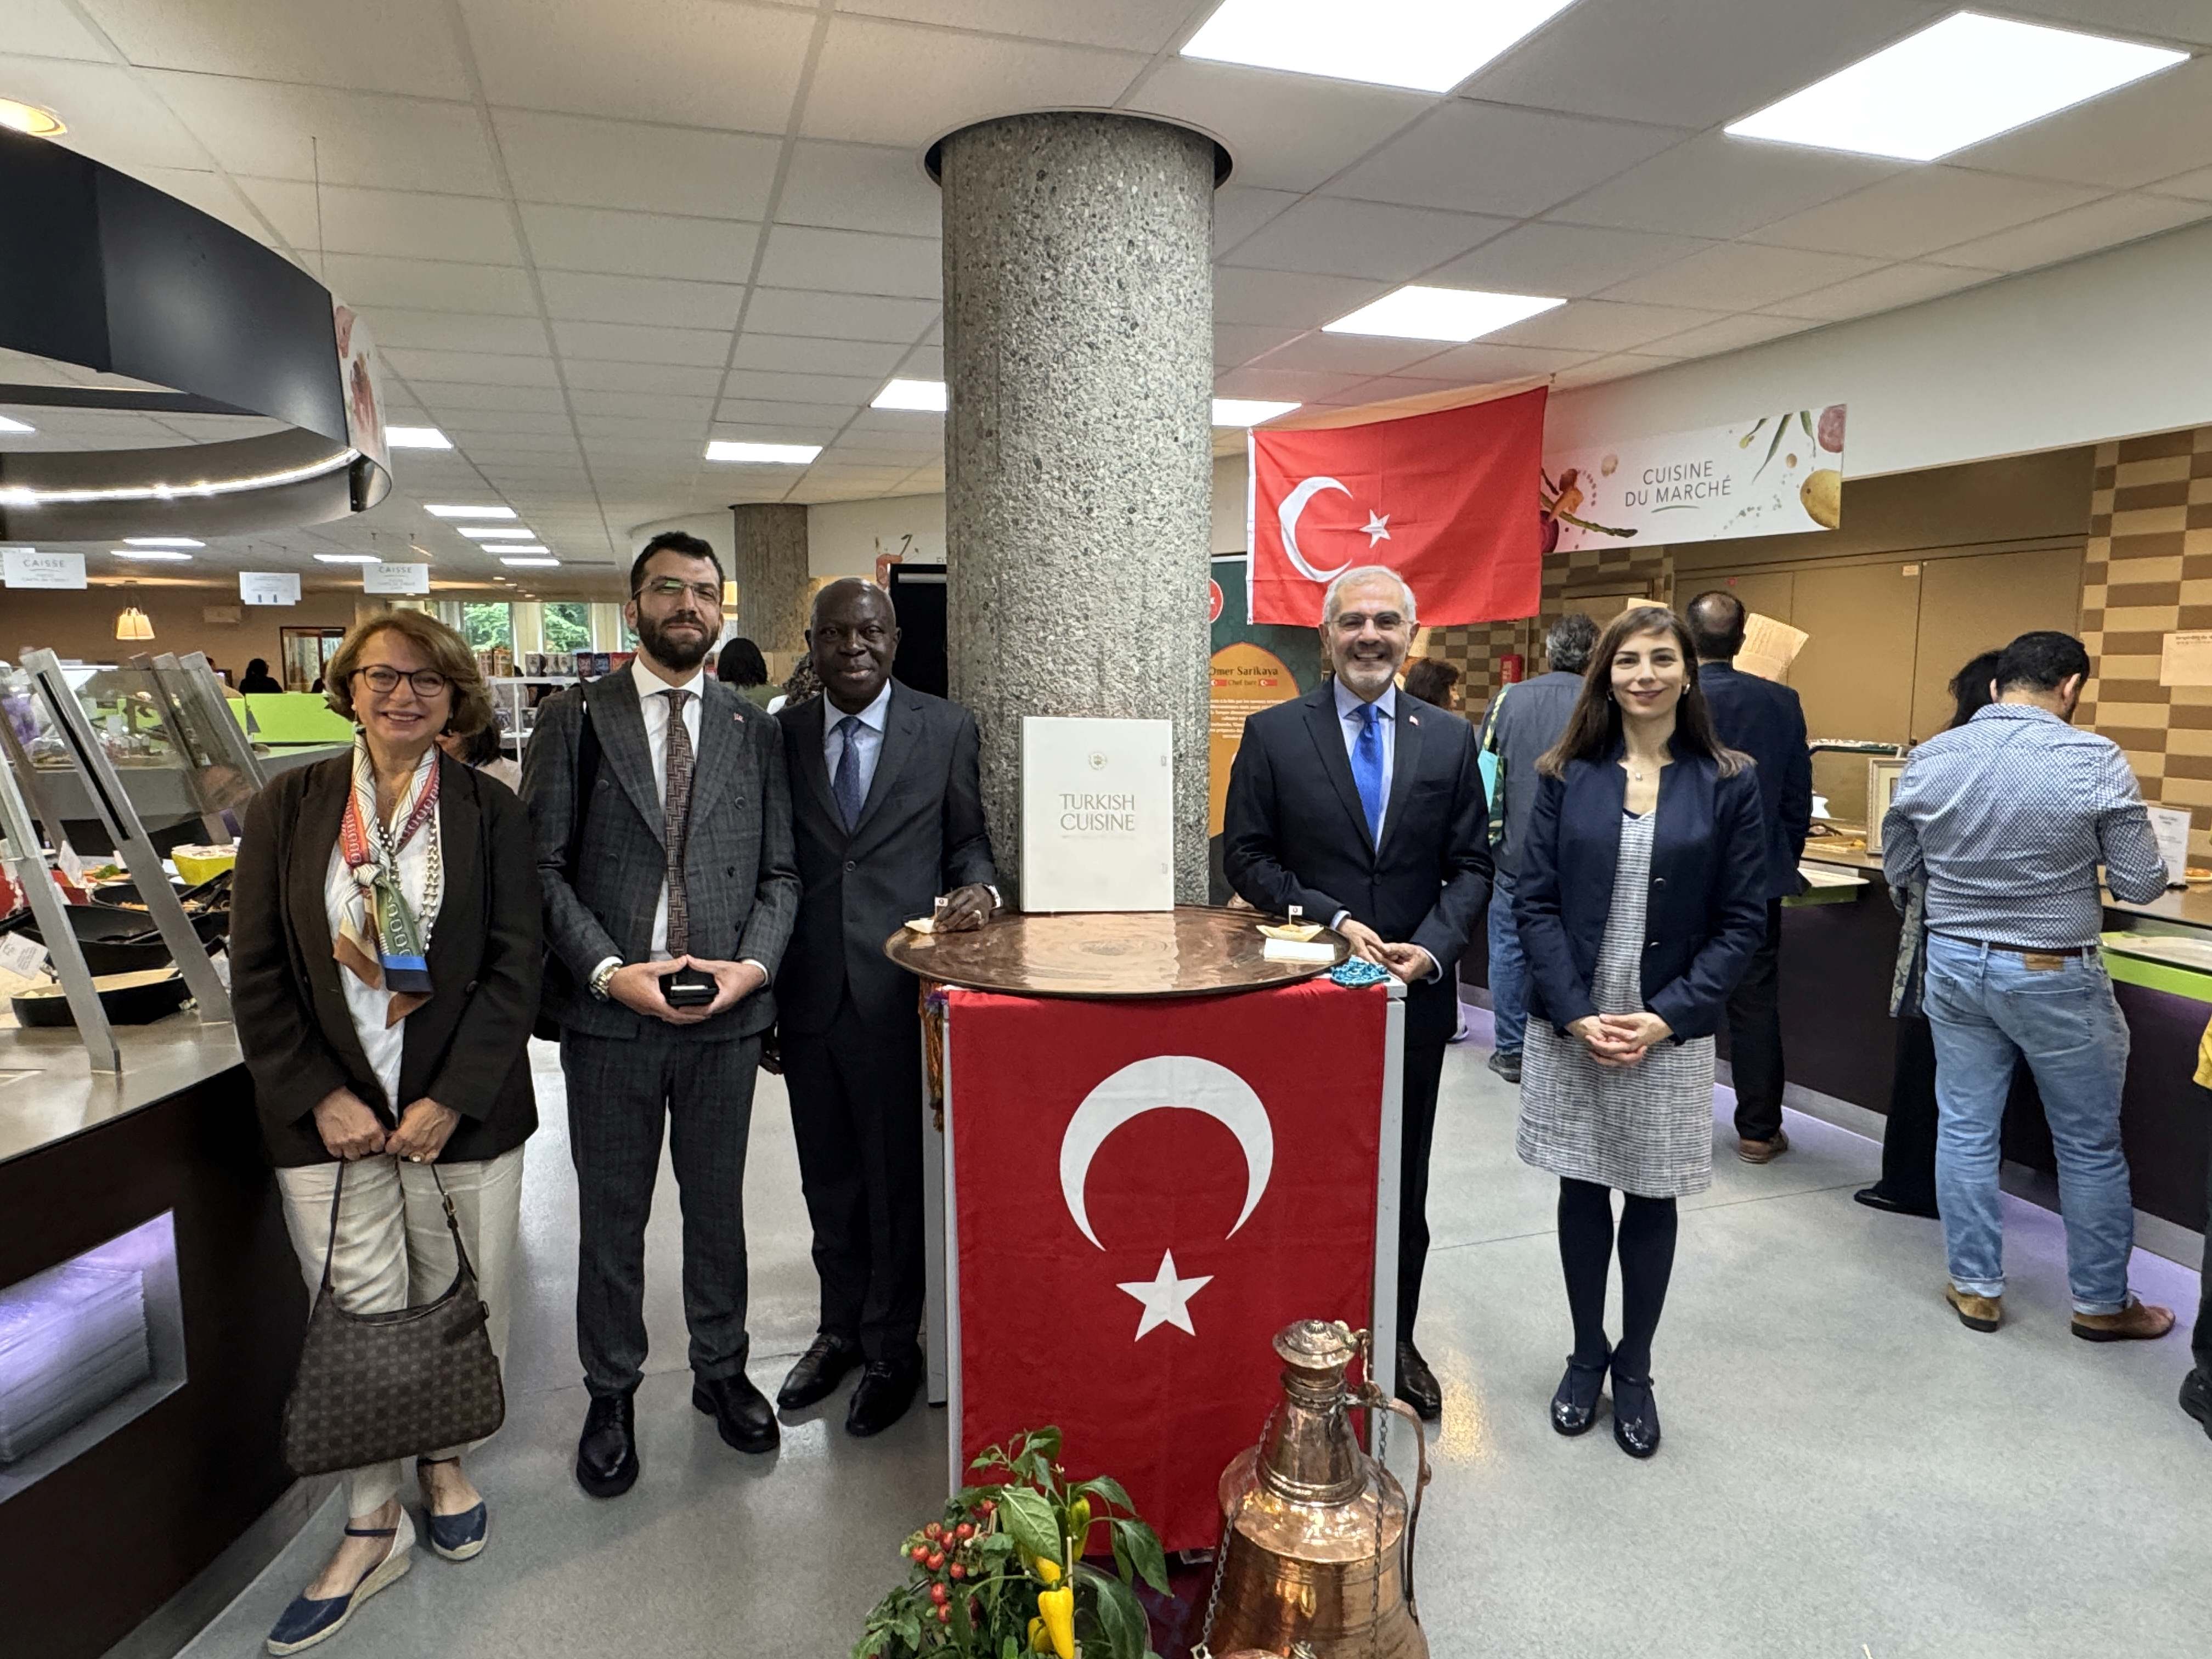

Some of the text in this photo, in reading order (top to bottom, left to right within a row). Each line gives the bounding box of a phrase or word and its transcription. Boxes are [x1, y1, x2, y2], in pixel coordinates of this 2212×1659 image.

[1643, 460, 1713, 485] CUISINE
[1625, 475, 1731, 506] DU MARCHÉ
[23, 559, 65, 567] CAISSE
[1059, 793, 1135, 810] TURKISH
[1060, 813, 1135, 831] CUISINE
